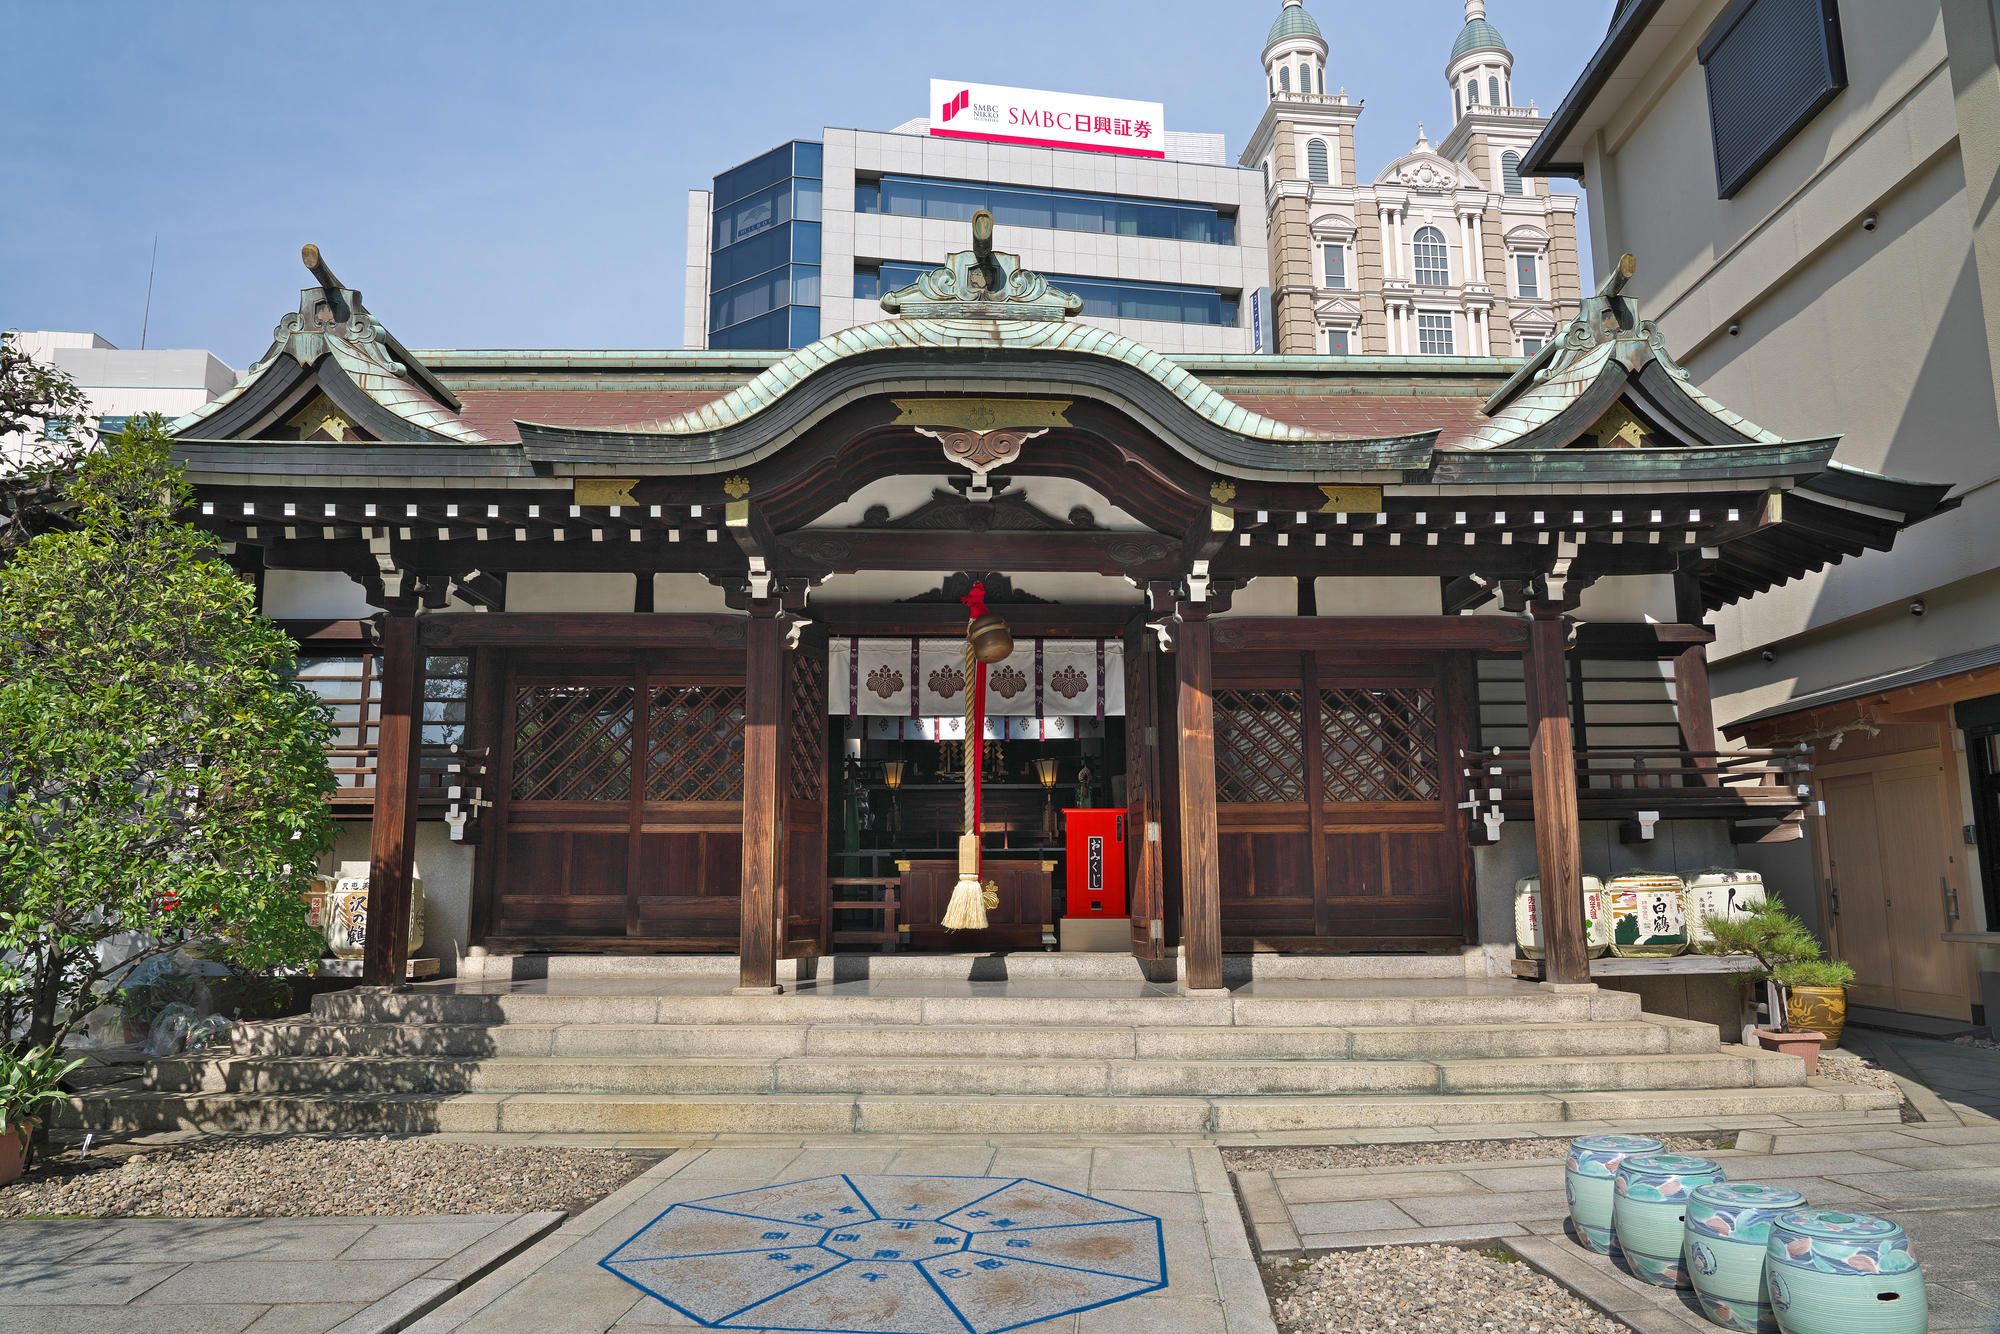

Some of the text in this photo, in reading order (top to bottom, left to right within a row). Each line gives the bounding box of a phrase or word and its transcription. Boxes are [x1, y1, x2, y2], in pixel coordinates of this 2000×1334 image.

[973, 103, 998, 112] SMBC
[1009, 107, 1152, 138] SMBC日興証券
[1090, 839, 1101, 887] おみくじ
[347, 895, 367, 946] 沢の鶴
[1653, 897, 1670, 933] 白鶴
